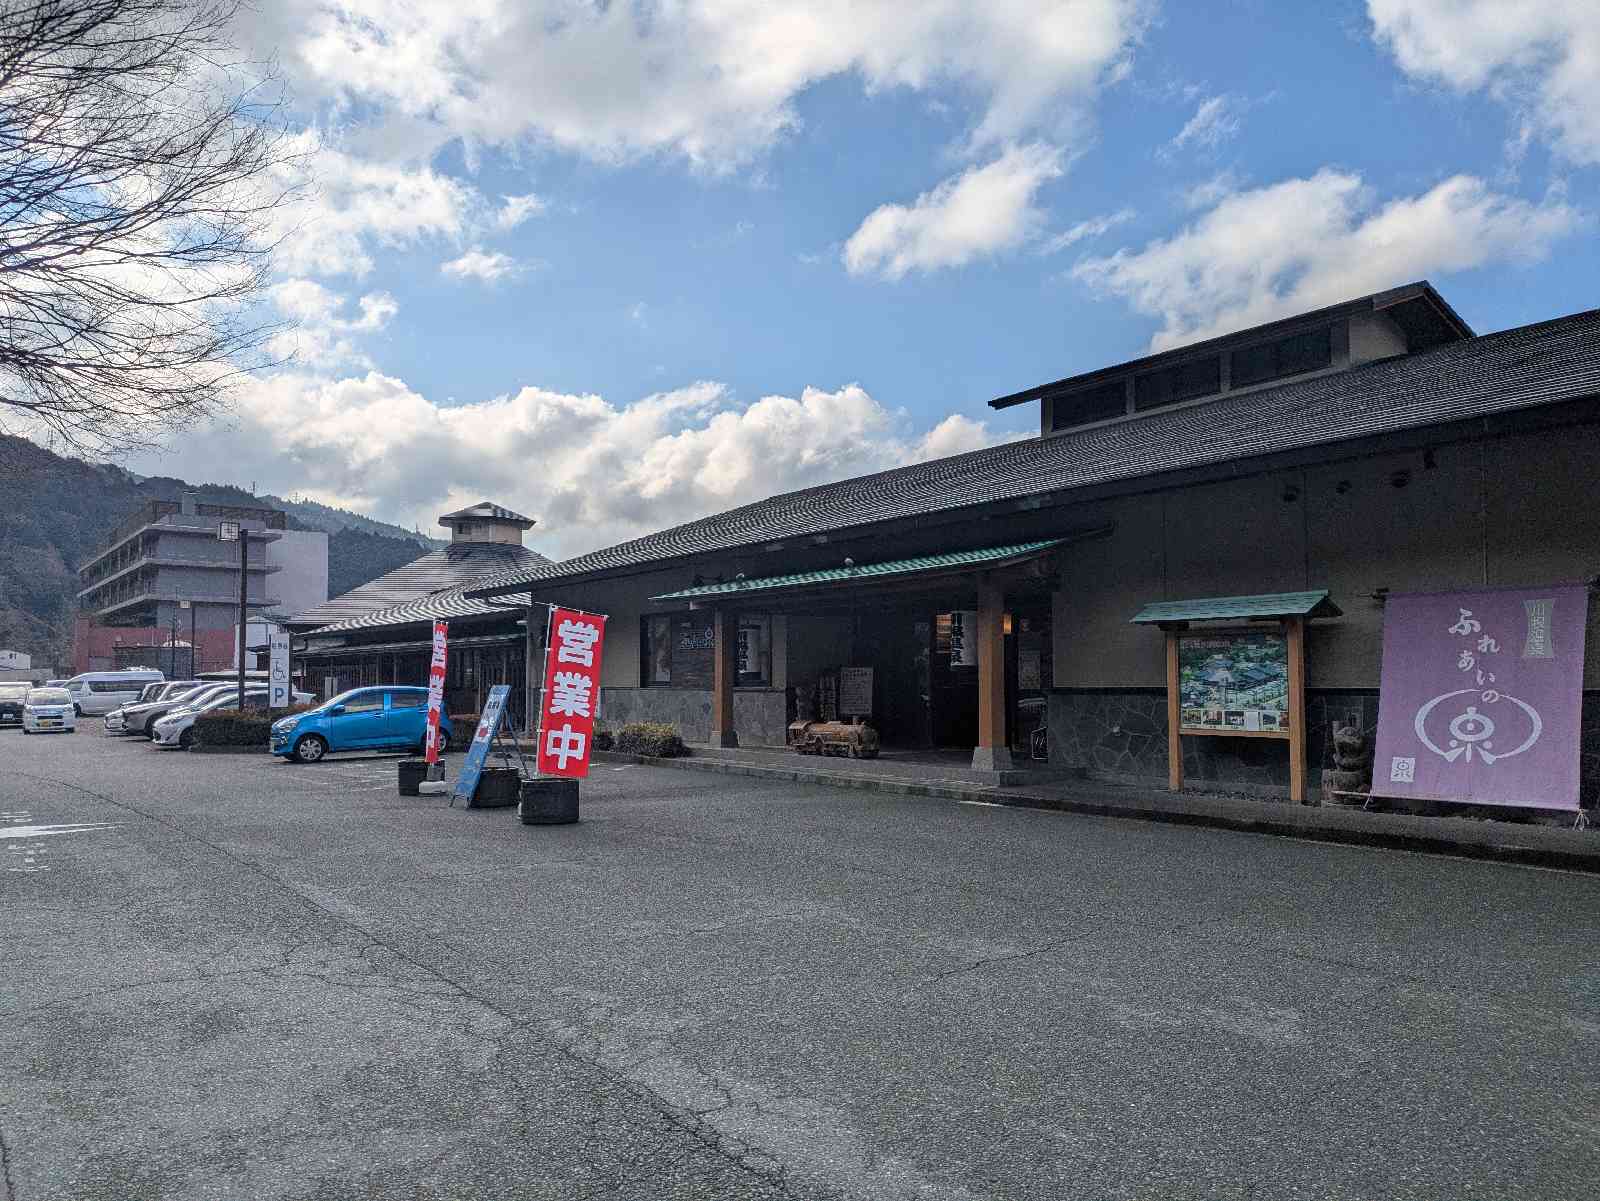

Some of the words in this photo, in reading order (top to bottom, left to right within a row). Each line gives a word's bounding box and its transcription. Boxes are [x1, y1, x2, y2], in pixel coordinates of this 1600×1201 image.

[274, 687, 285, 704] P
[546, 619, 599, 770] 営業中
[1448, 608, 1501, 704] ふれあいの
